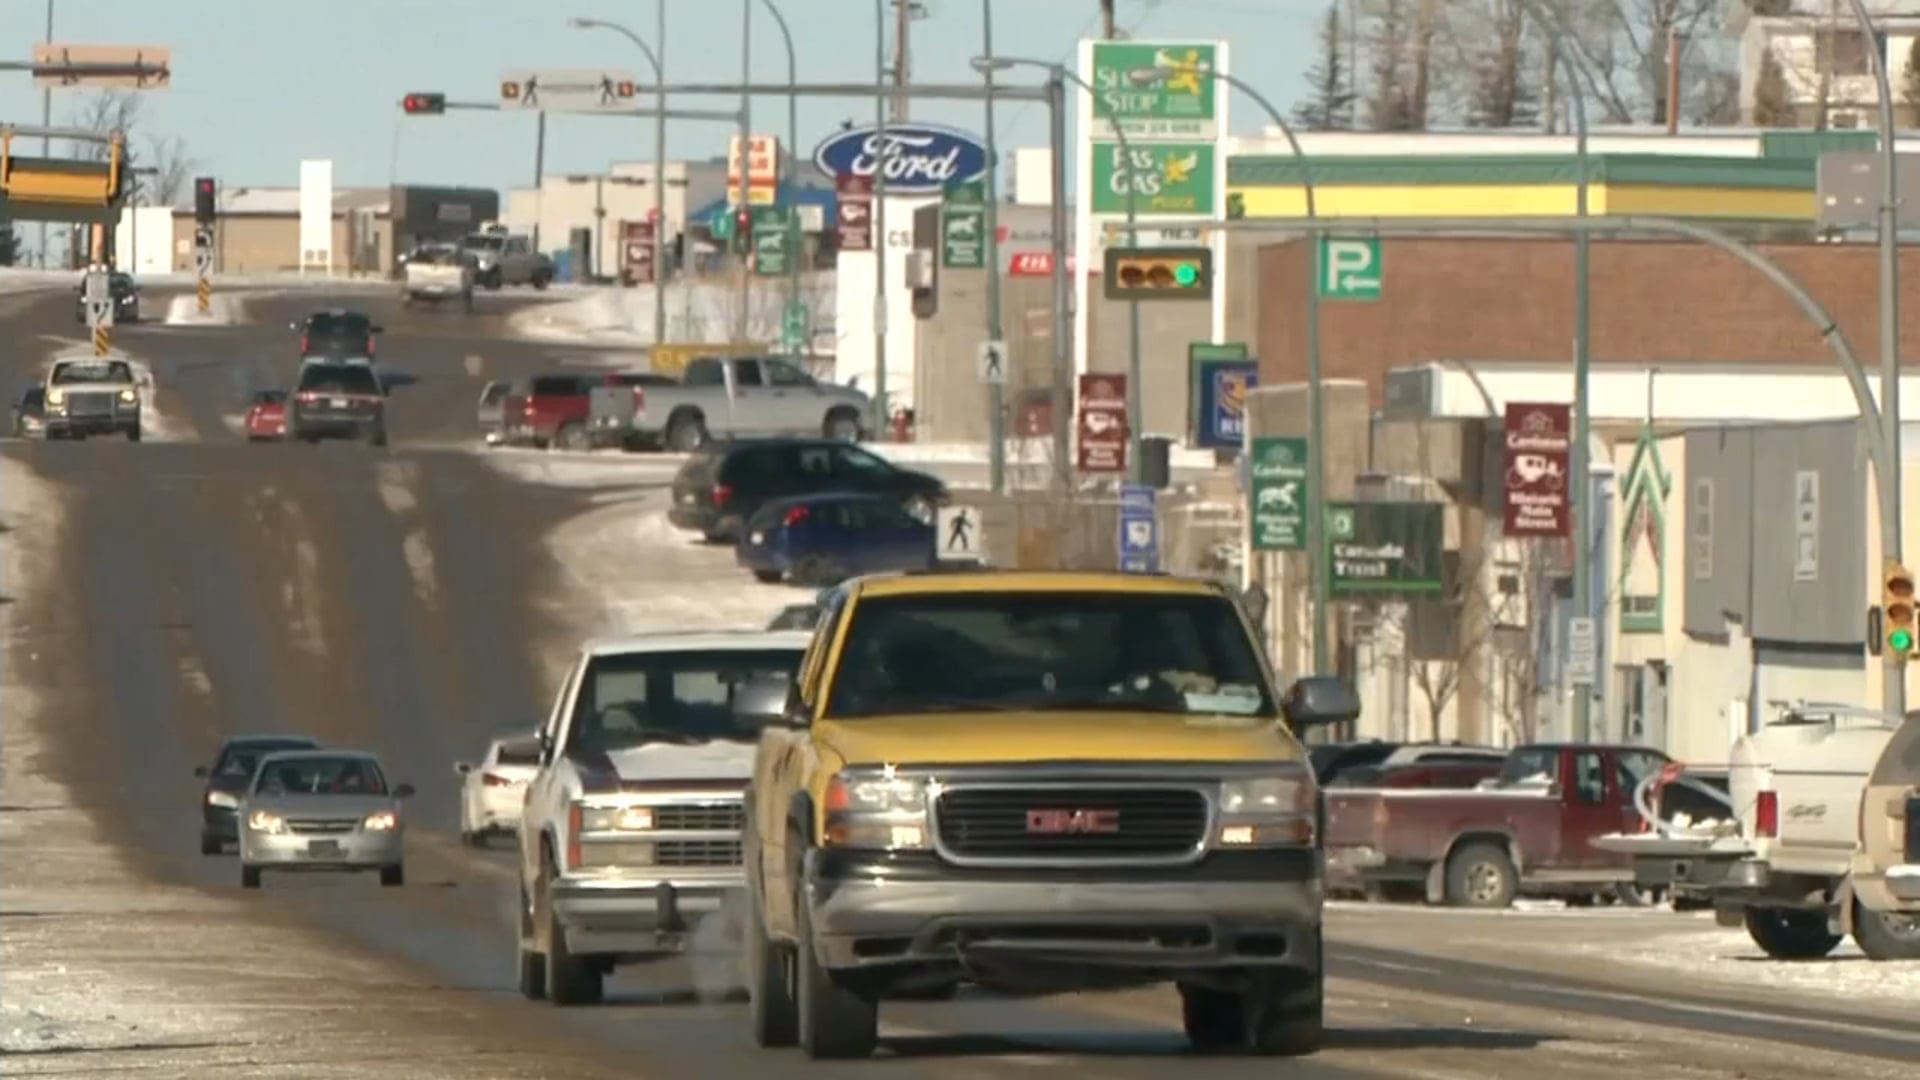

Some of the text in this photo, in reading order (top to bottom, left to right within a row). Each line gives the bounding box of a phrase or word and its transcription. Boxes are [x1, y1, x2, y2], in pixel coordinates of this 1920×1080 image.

[852, 134, 960, 180] Ford
[1328, 241, 1371, 291] P
[1333, 542, 1404, 558] Canada
[1334, 561, 1387, 576] Trust
[1026, 809, 1119, 833] GMC
